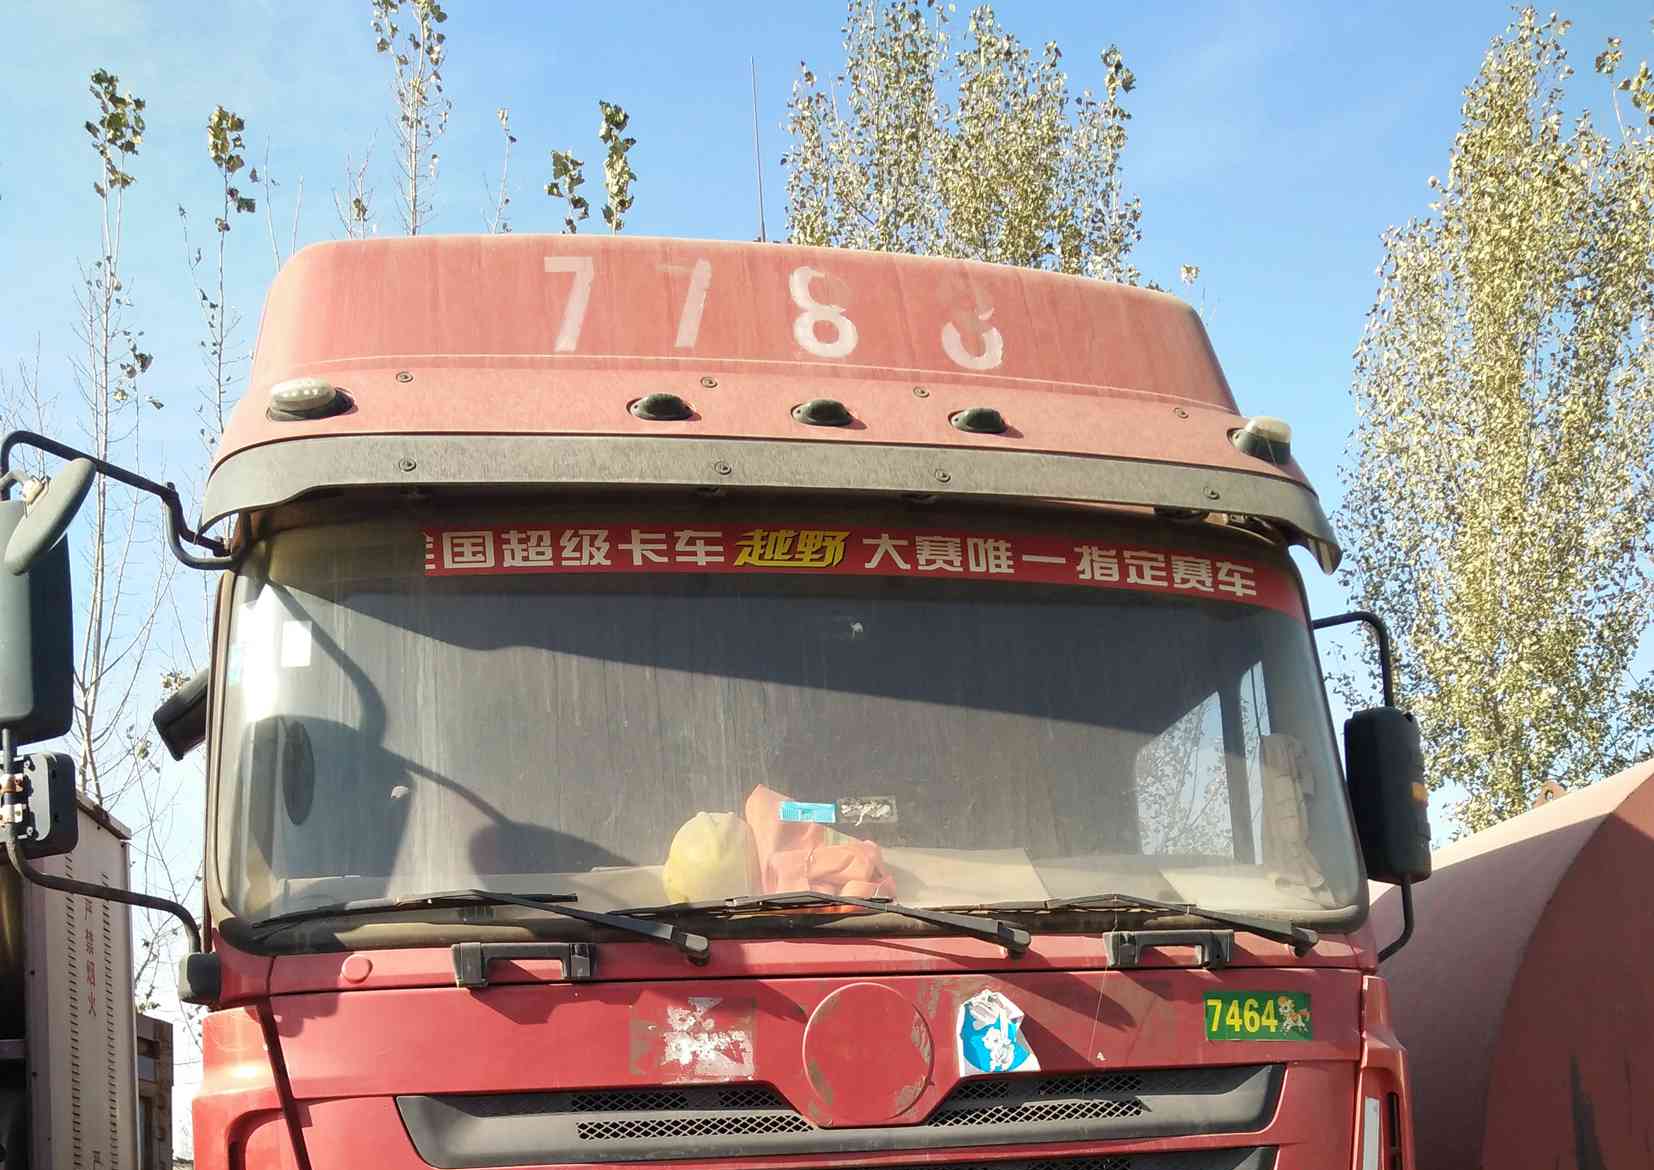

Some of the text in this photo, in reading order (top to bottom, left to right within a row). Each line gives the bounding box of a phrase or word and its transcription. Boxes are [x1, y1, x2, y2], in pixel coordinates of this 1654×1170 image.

[425, 529, 1256, 597] 国超级卡车越野大赛唯一指定赛车
[1206, 998, 1278, 1033] 7464
